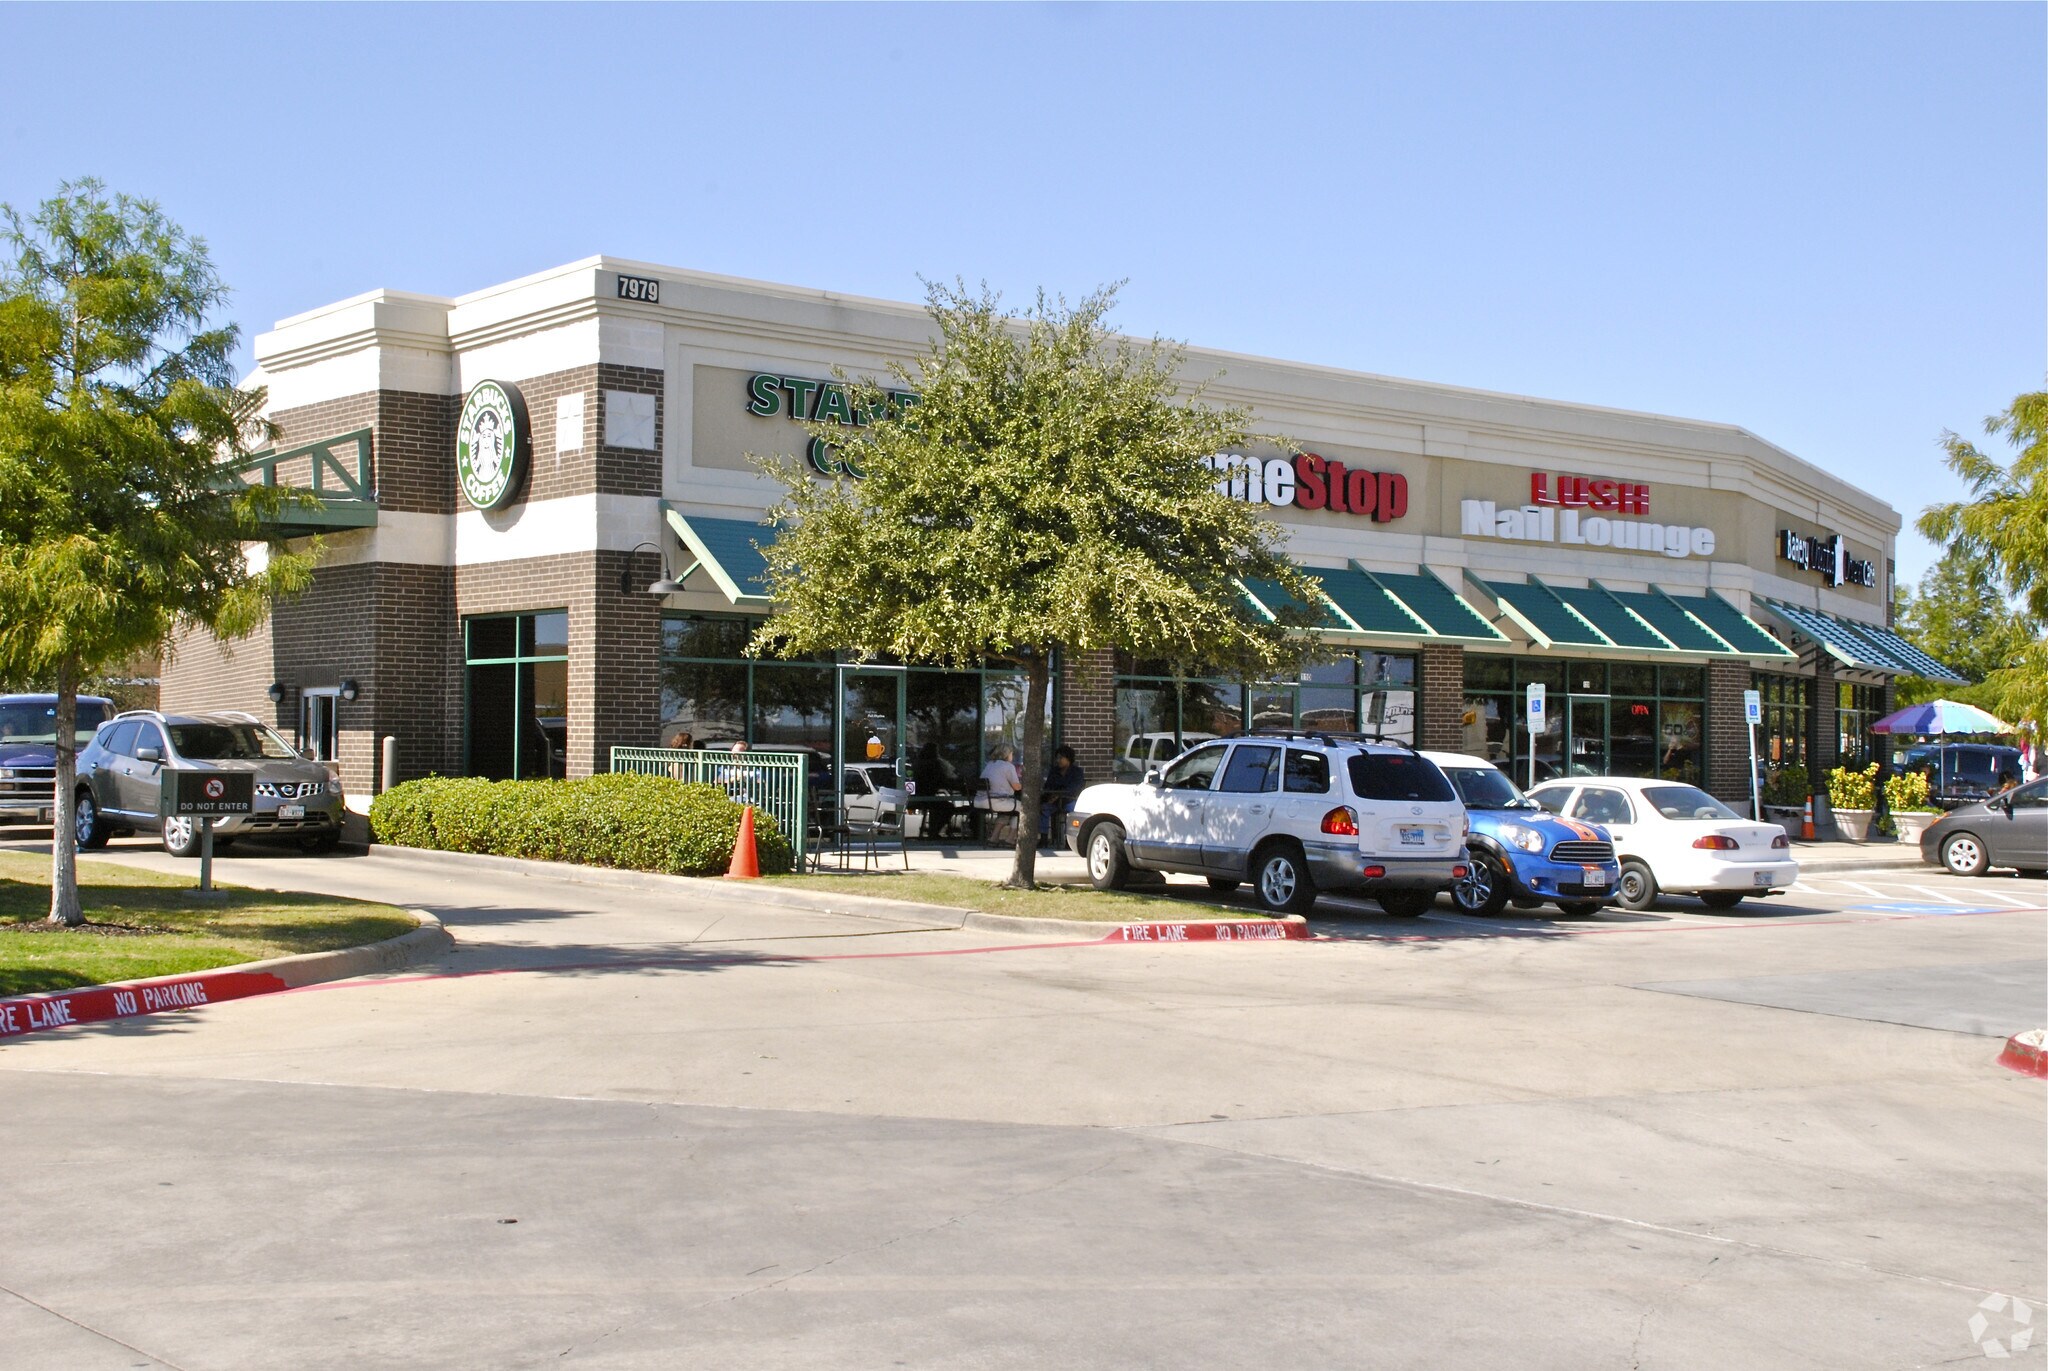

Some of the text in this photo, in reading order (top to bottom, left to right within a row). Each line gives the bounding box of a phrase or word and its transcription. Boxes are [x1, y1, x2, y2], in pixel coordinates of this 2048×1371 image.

[620, 277, 658, 301] 7979
[460, 388, 512, 444] STARBUCKS
[466, 470, 506, 502] COFFEE
[1202, 452, 1408, 523] meStop
[1531, 472, 1649, 515] LUSH
[1461, 500, 1715, 558] Nail Lounge
[180, 802, 248, 811] DO NOT ENTER
[1122, 925, 1152, 941] FIRE
[1156, 925, 1188, 941] LANE
[1215, 925, 1232, 941] NO
[0, 982, 207, 1033] RE LANE NO PARKING
